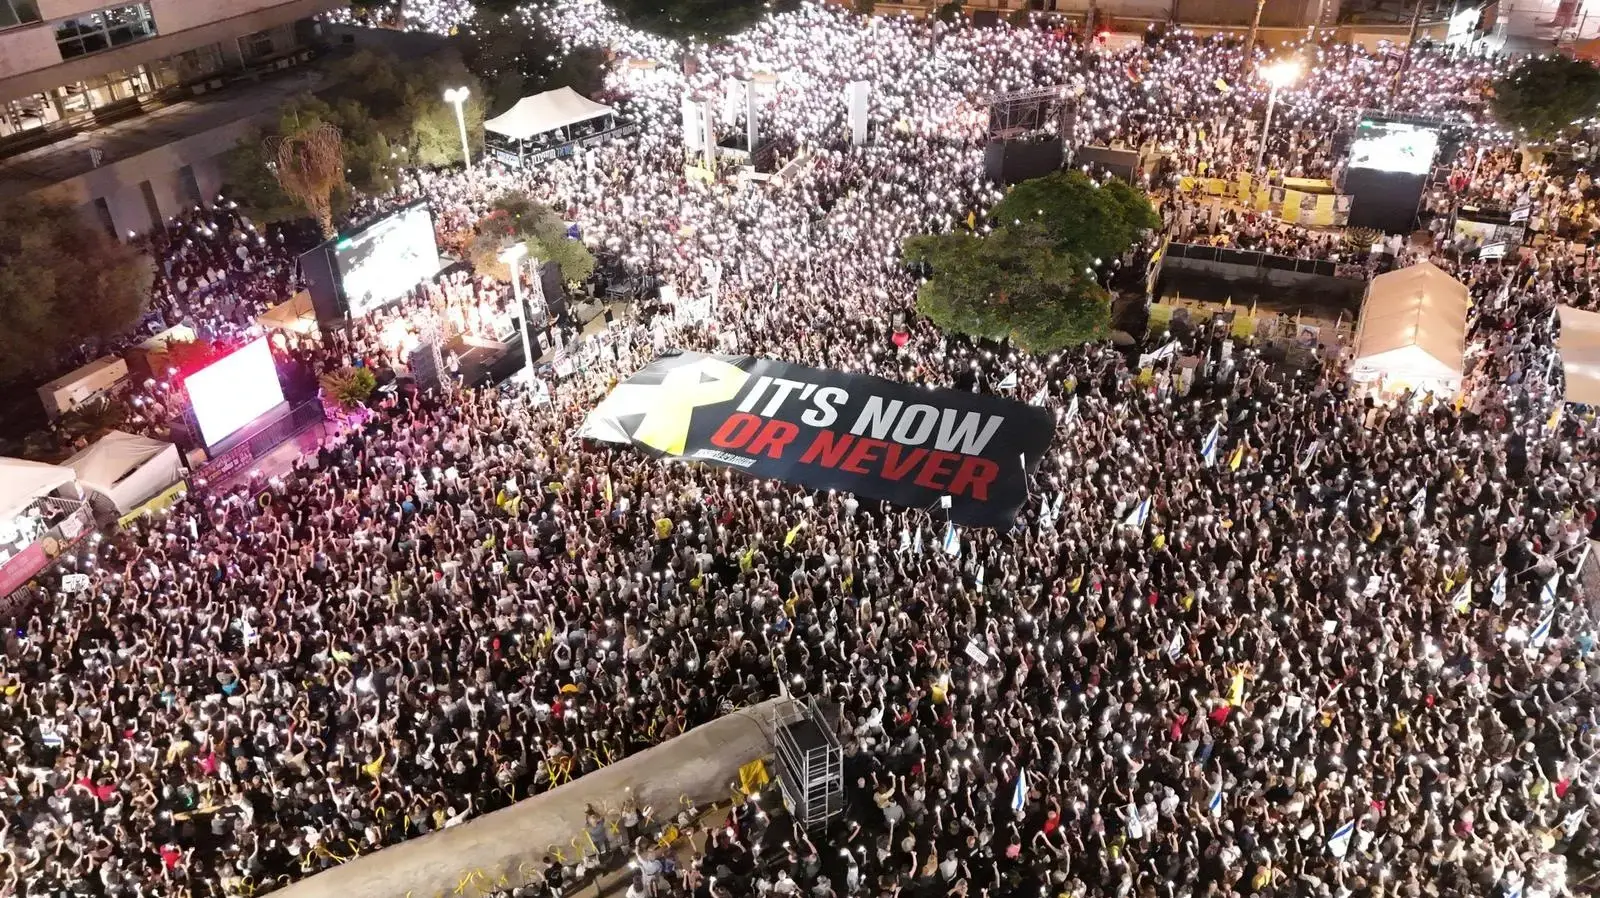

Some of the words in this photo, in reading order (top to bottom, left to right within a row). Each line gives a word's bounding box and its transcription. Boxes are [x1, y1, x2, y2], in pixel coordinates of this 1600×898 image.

[710, 413, 800, 459] OR
[801, 430, 1000, 500] NEVER
[736, 376, 850, 428] IT'S
[850, 396, 1005, 456] NOW
